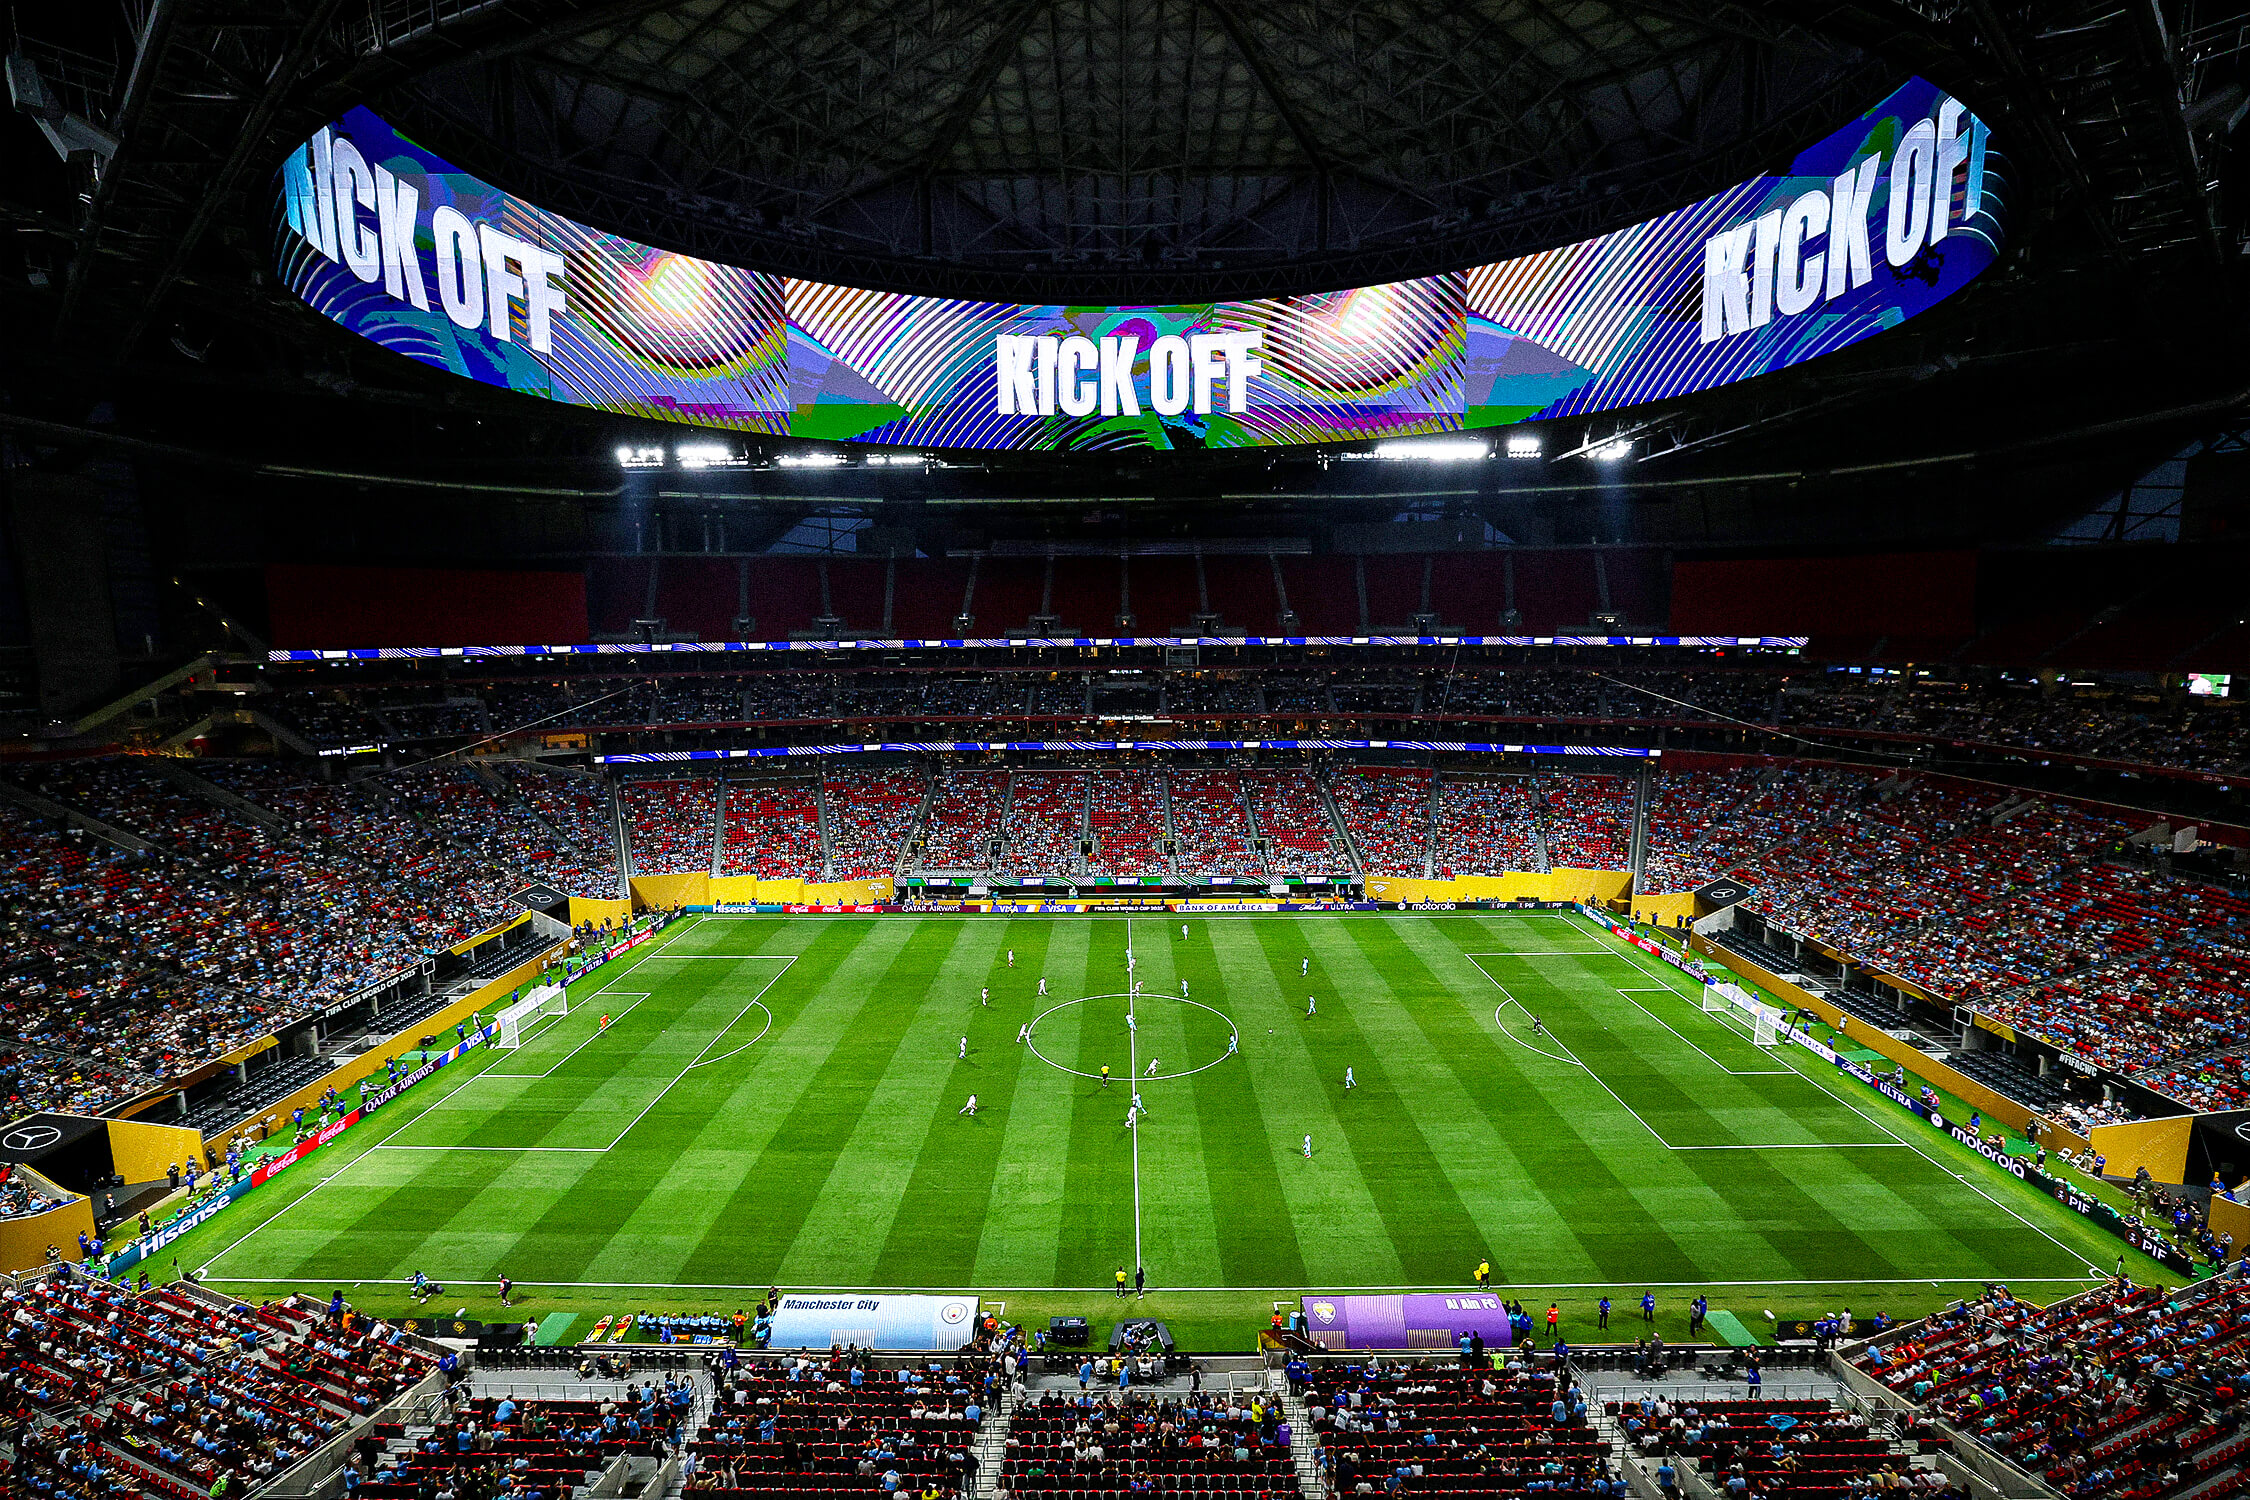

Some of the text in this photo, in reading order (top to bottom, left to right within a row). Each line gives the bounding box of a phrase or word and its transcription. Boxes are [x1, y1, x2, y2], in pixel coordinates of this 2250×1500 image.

[283, 126, 567, 355] KICK OFF
[1700, 151, 1881, 344] KICK
[996, 331, 1263, 416] KICK OFF
[712, 905, 757, 913] Hisense
[1048, 905, 1067, 913] VISA
[1412, 902, 1456, 911] motorola
[1582, 905, 1607, 928] Hisense
[585, 957, 604, 973] ULTRA
[325, 1004, 342, 1018] FIFA
[342, 994, 361, 1009] CLUB
[361, 983, 386, 1000] WORLD
[386, 977, 400, 988] CUP
[467, 1030, 486, 1050] VISA
[2059, 1053, 2098, 1077] #FIFACWC
[365, 1064, 435, 1113] QATAR AIRWAYS
[1879, 1082, 1912, 1110] ULTRA
[244, 1113, 277, 1136] Hisese
[1951, 1127, 2025, 1179] motorola
[2068, 1195, 2091, 1214] PIF
[139, 1194, 231, 1260] Hisense
[2142, 1239, 2168, 1260] PIF
[783, 1299, 880, 1312] Manchester City
[1445, 1297, 1498, 1310] Al Ain FC
